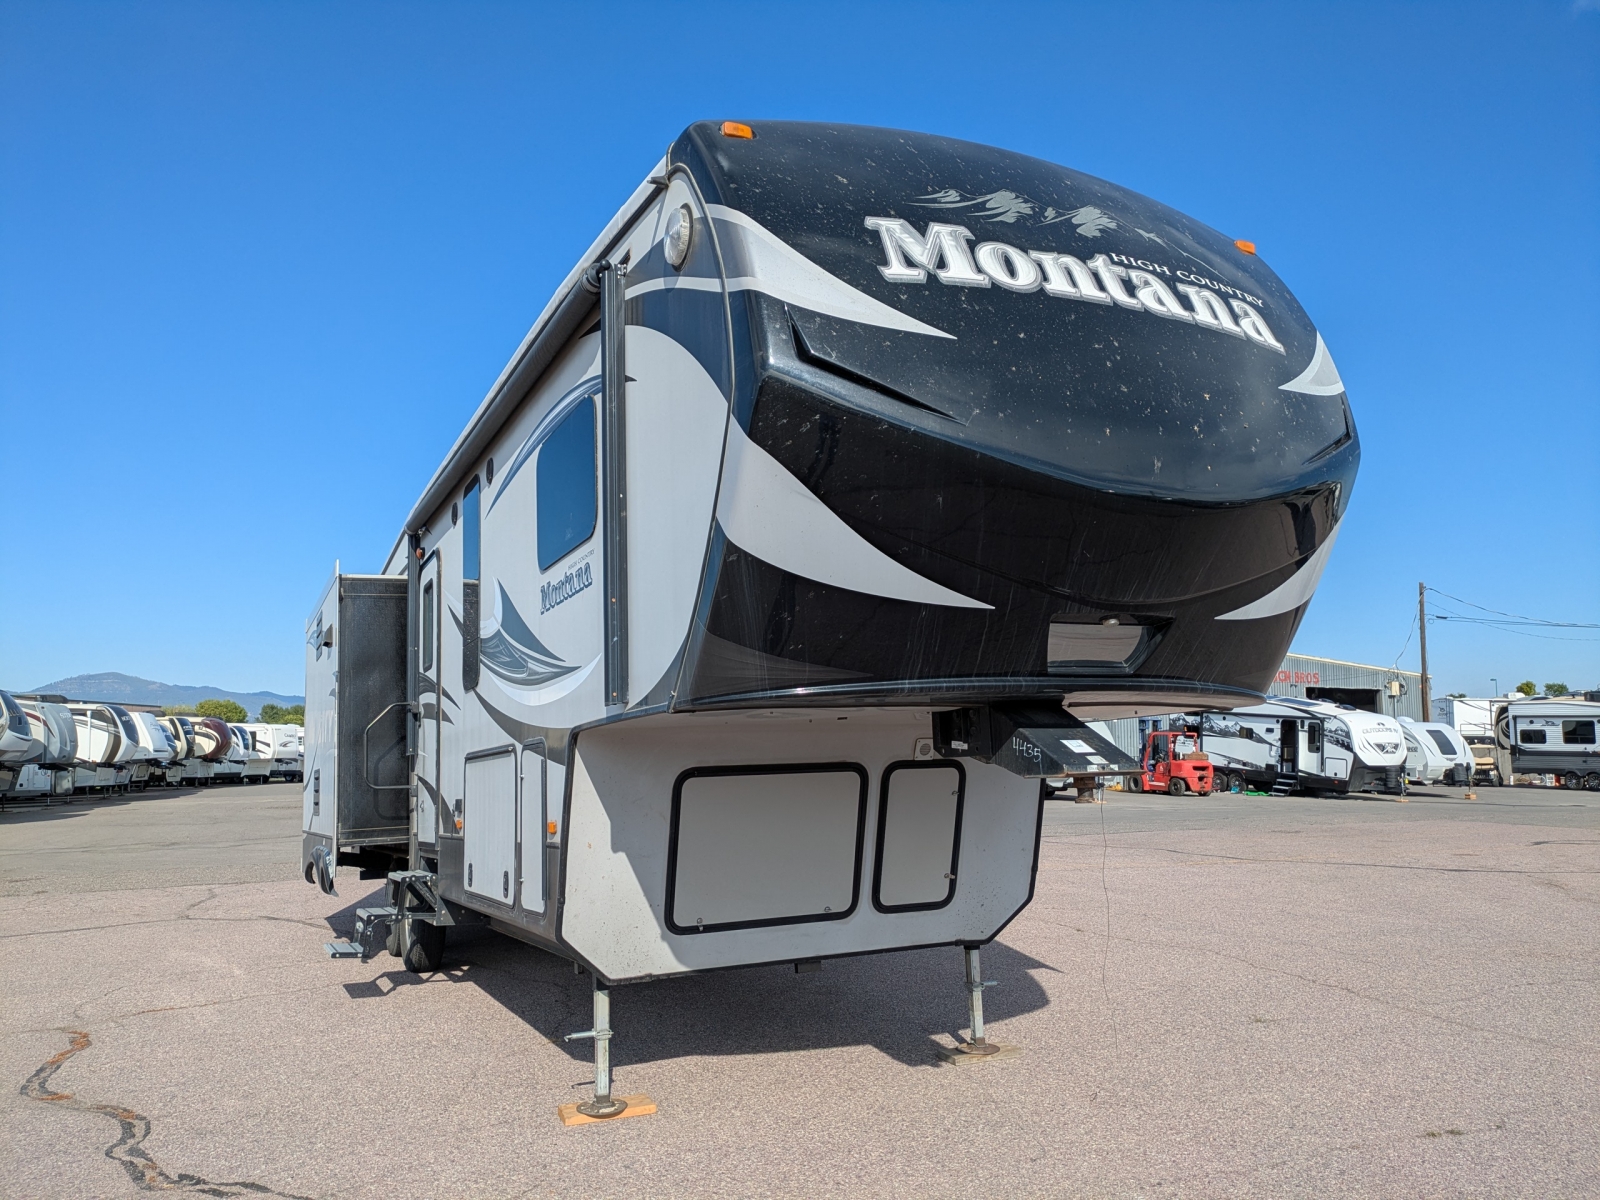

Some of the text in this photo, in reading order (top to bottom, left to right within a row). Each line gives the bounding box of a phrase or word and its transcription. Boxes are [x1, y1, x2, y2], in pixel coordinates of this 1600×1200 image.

[864, 215, 1286, 355] Montana
[1109, 252, 1264, 308] HIGH COUNTRY
[540, 561, 593, 615] Montana
[1294, 671, 1320, 684] BROS
[1012, 736, 1042, 763] 4435
